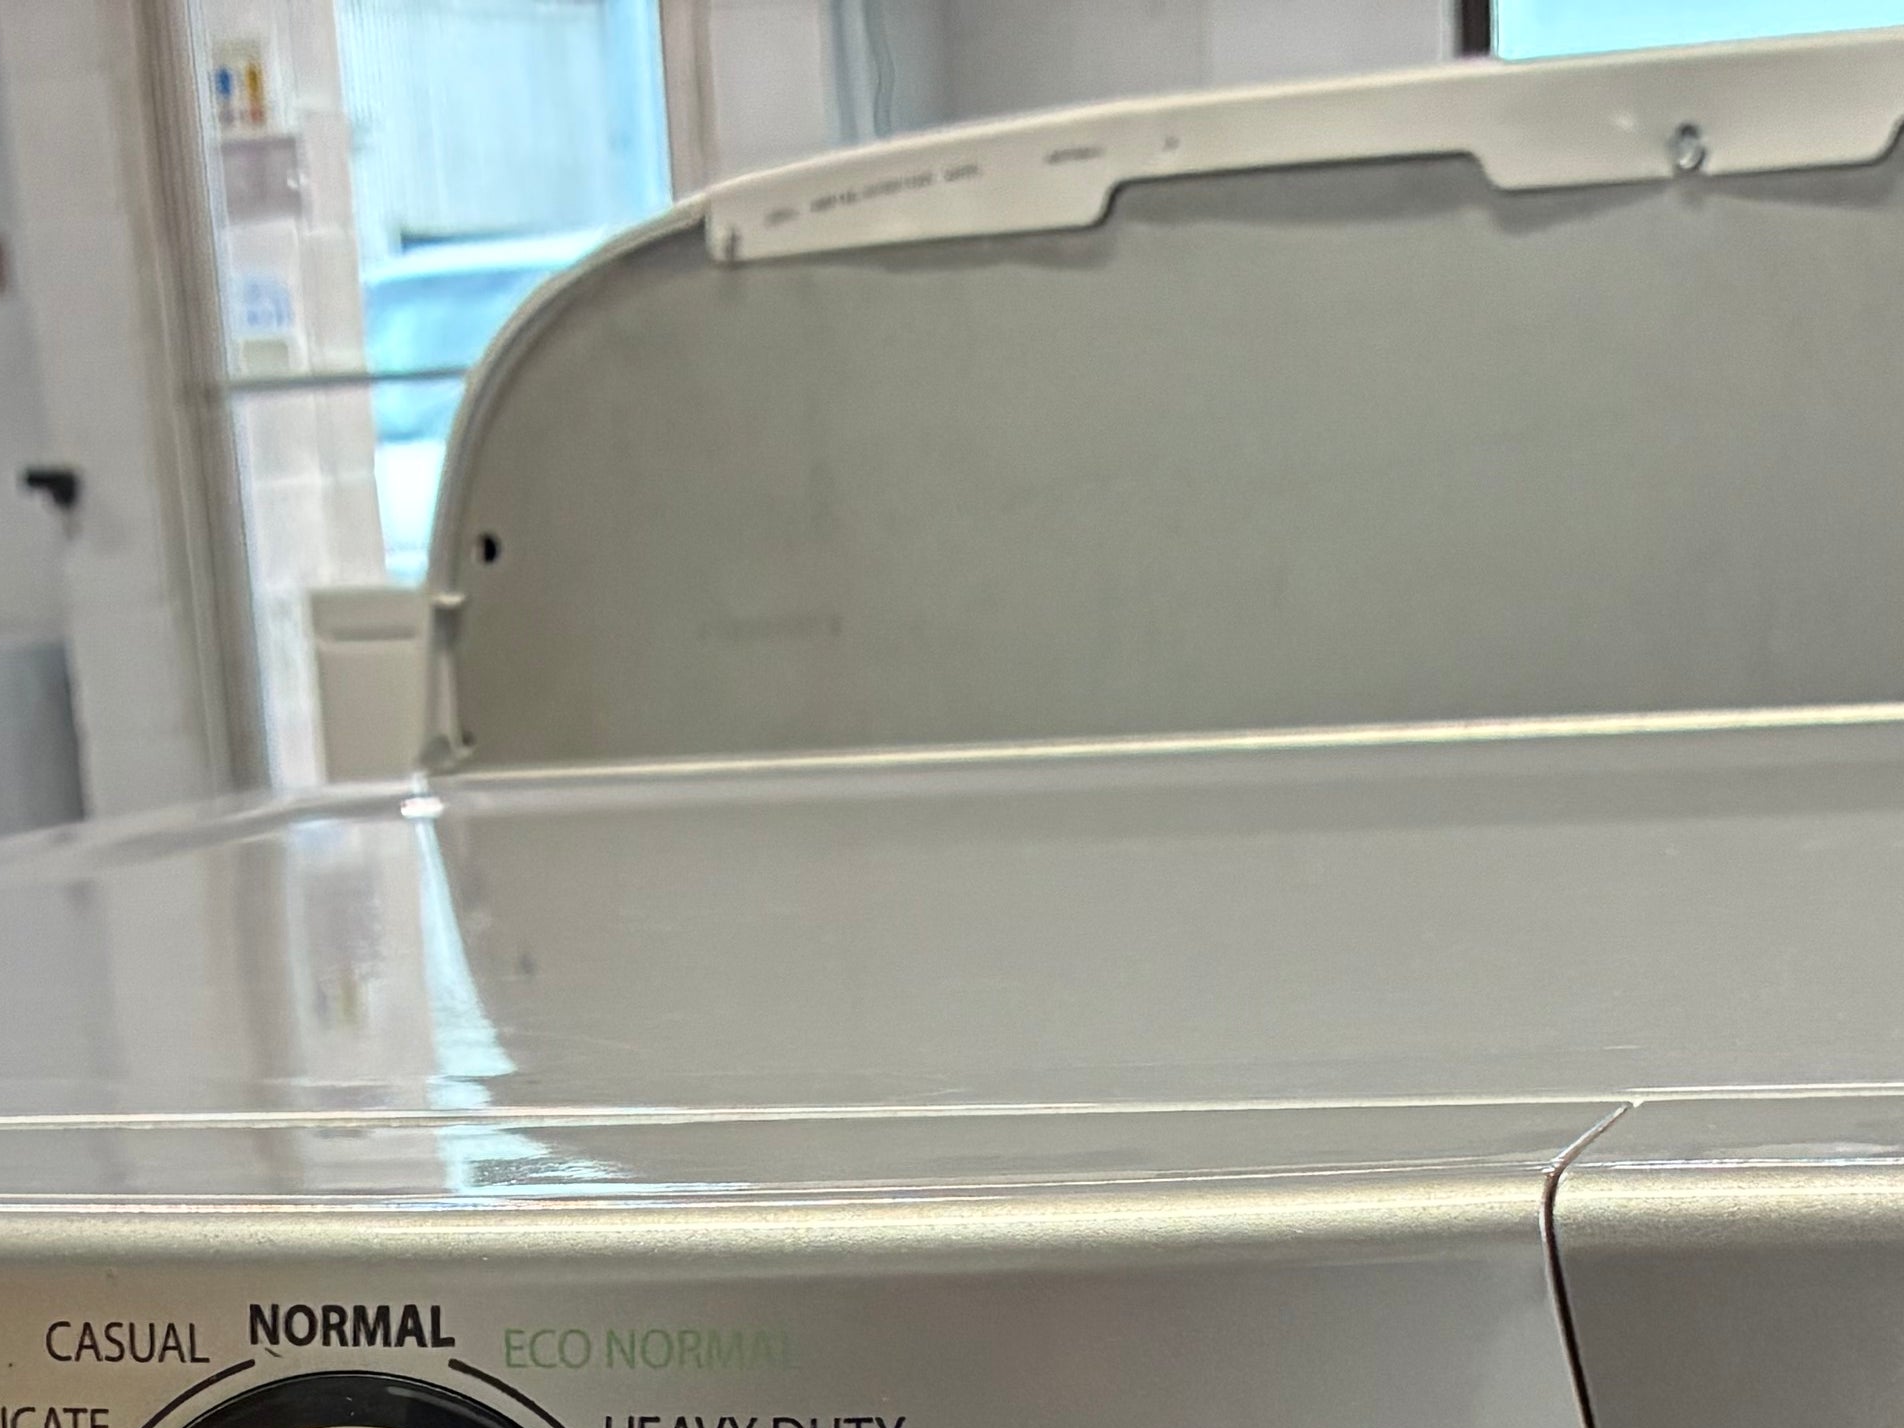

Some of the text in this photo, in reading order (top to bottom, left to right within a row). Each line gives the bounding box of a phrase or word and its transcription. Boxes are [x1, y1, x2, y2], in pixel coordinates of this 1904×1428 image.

[46, 1321, 210, 1363] CASUAL
[250, 1304, 455, 1347] NORMAL
[505, 1329, 591, 1369] ECO
